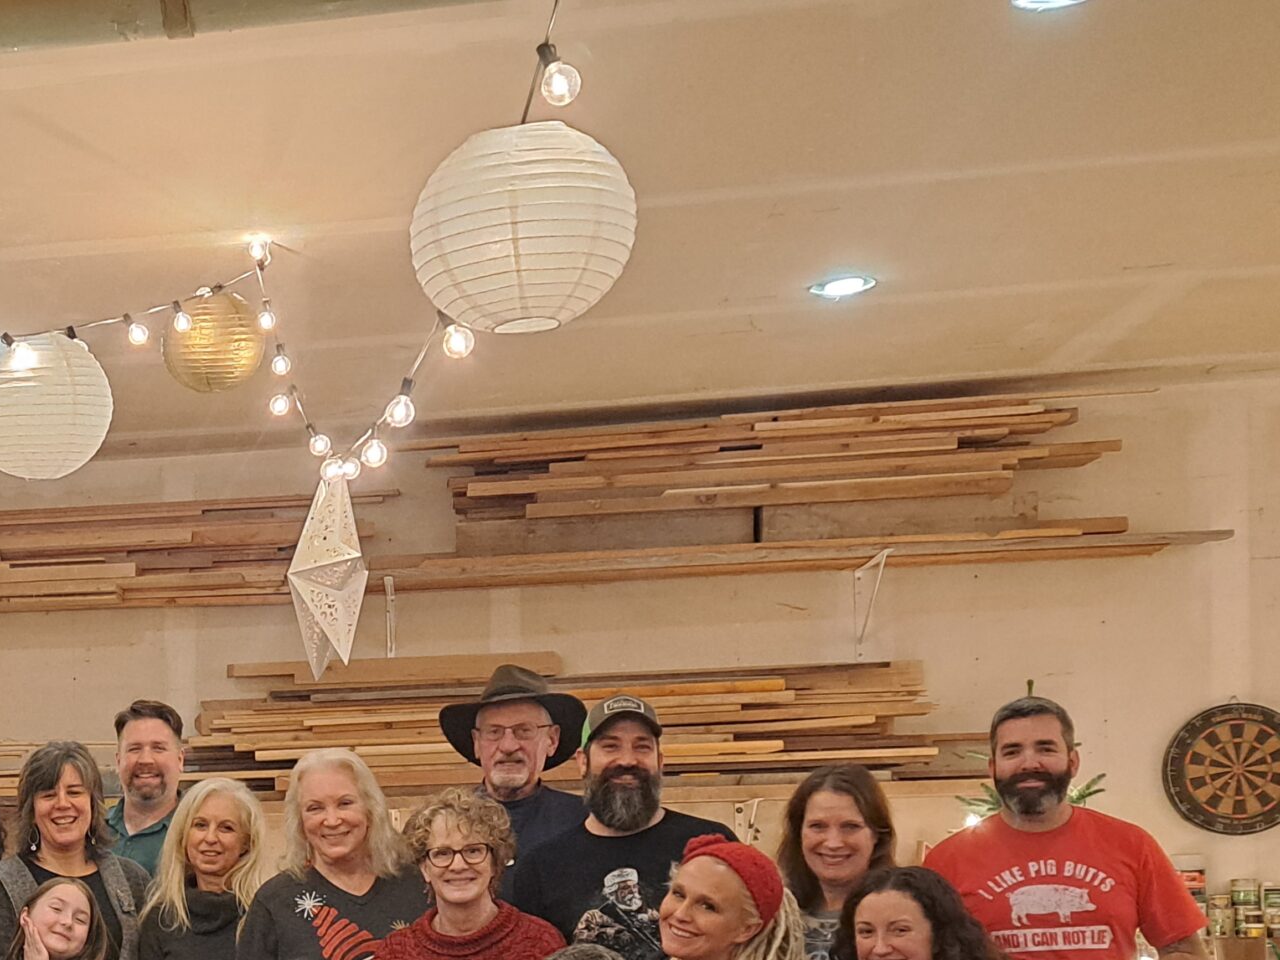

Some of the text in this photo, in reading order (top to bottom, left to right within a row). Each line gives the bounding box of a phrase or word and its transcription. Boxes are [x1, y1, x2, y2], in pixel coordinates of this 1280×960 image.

[977, 859, 1116, 900] I LIKE PIG BUTTS
[1023, 932, 1028, 947] I
[1032, 932, 1059, 947] CAN
[1063, 930, 1088, 945] NOT
[1091, 929, 1108, 945] LIE
